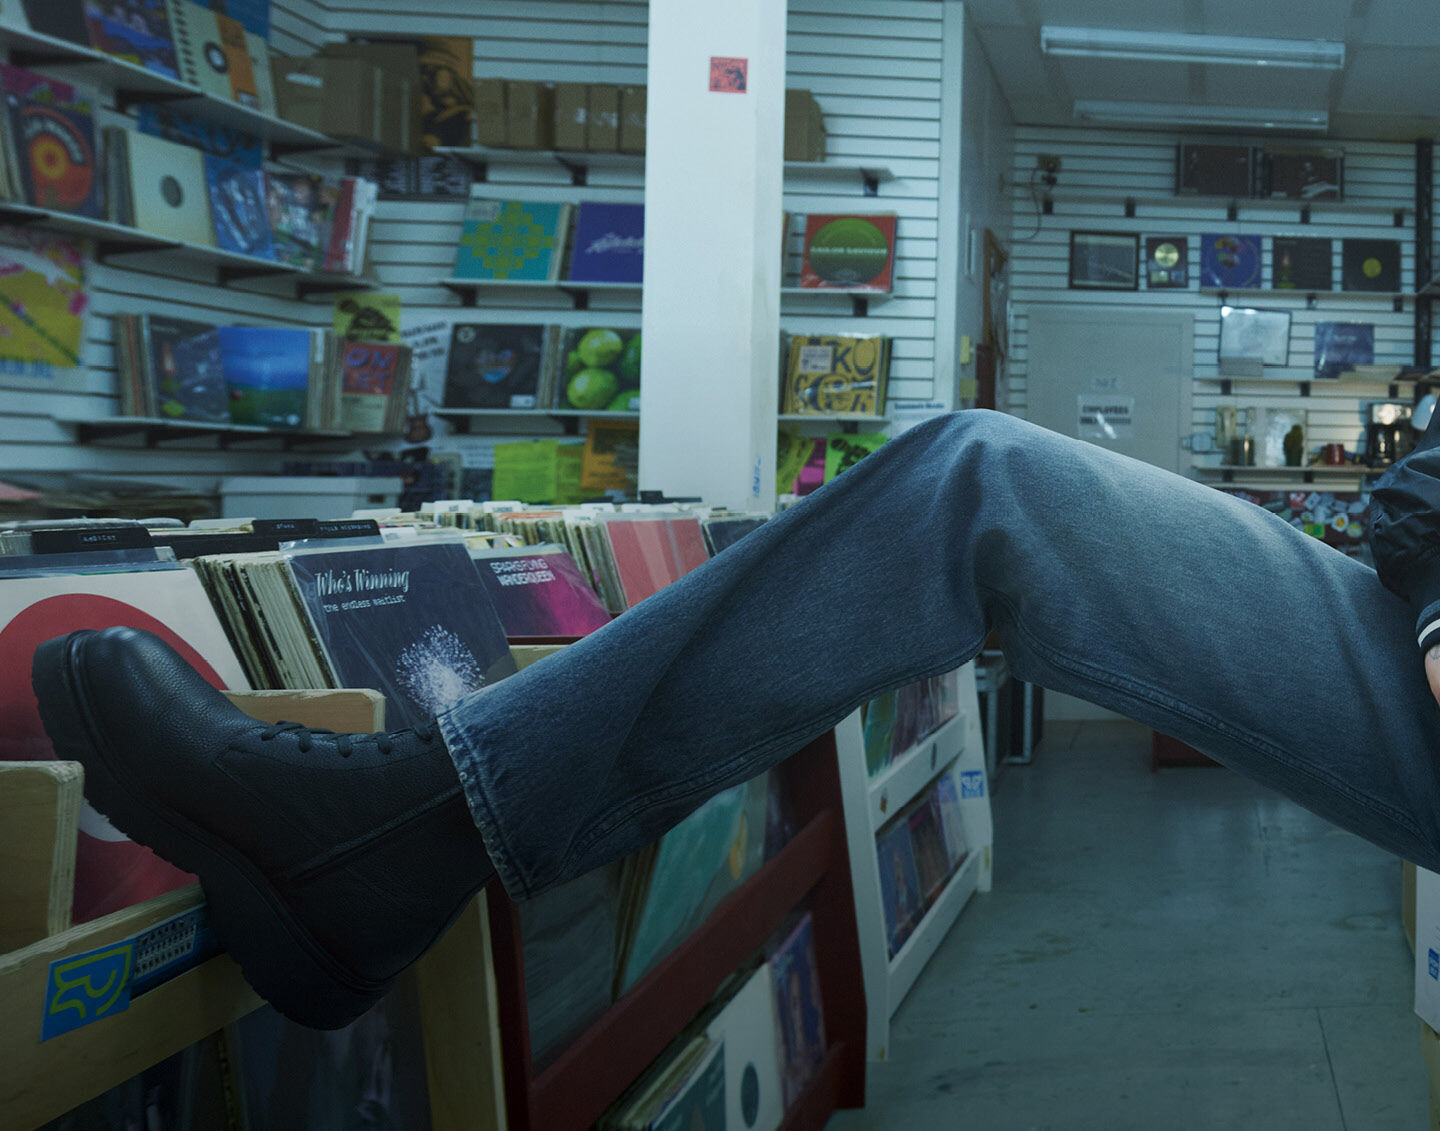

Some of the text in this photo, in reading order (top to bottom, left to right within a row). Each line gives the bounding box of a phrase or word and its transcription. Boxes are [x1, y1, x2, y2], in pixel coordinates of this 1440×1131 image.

[314, 567, 410, 597] Who's Winning
[323, 593, 406, 613] the endless waitlist
